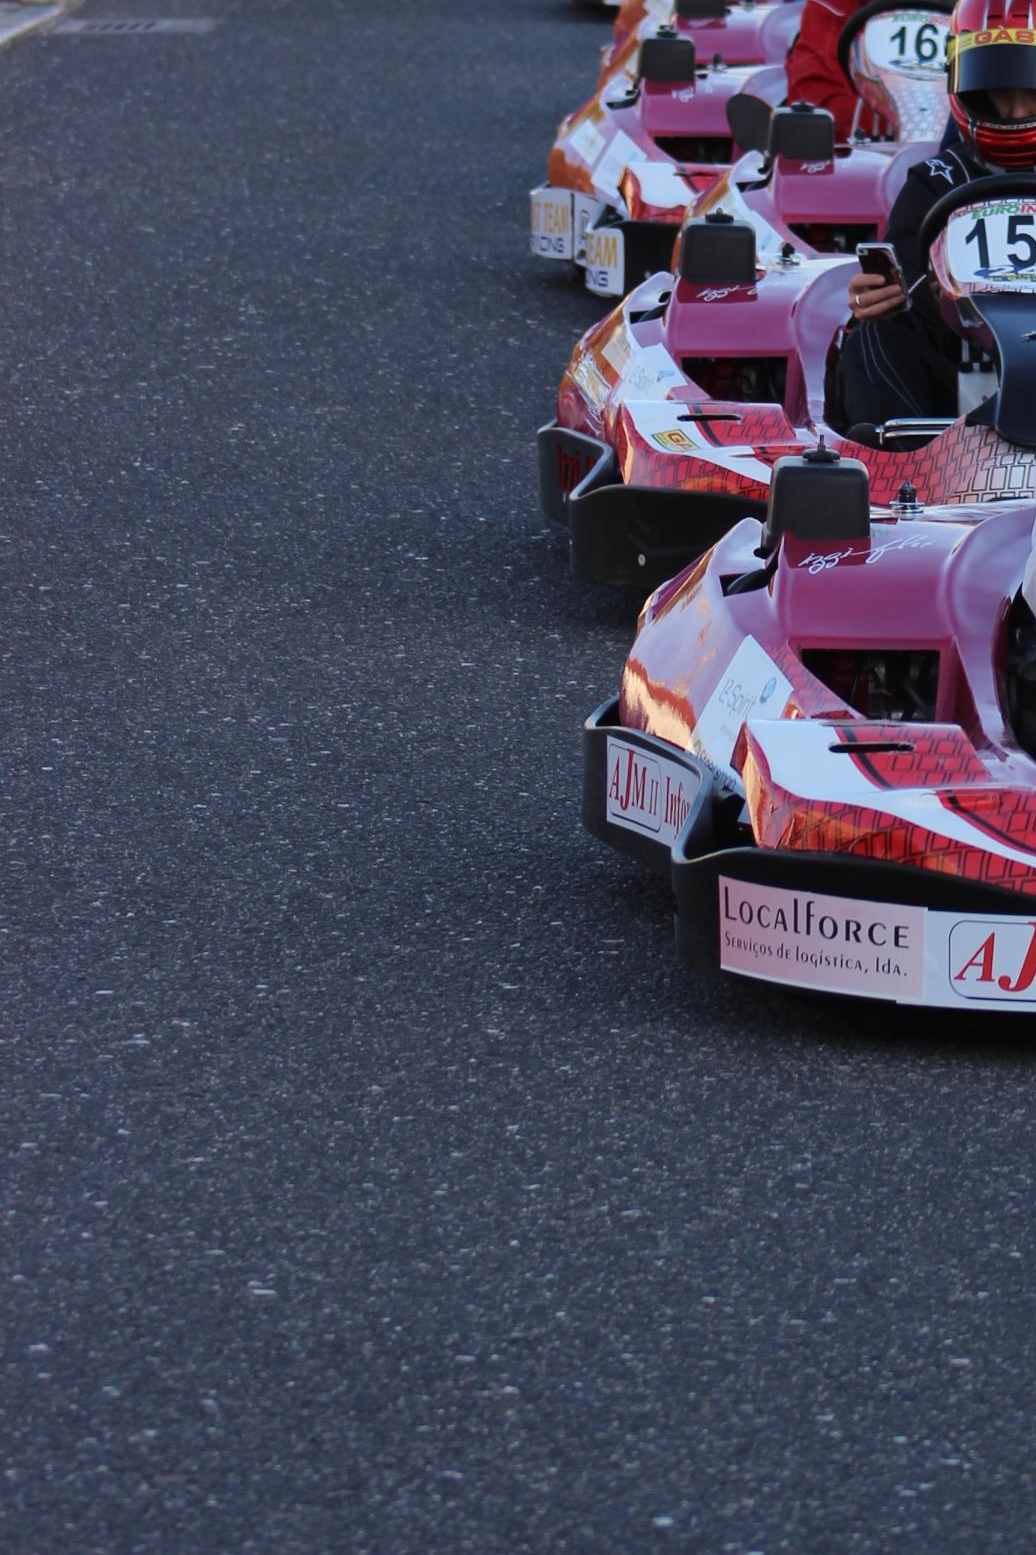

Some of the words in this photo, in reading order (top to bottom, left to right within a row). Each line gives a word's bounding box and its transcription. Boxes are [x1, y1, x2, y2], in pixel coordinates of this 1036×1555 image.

[889, 23, 949, 62] 16
[974, 29, 1035, 45] GAS
[608, 748, 647, 811] AJM
